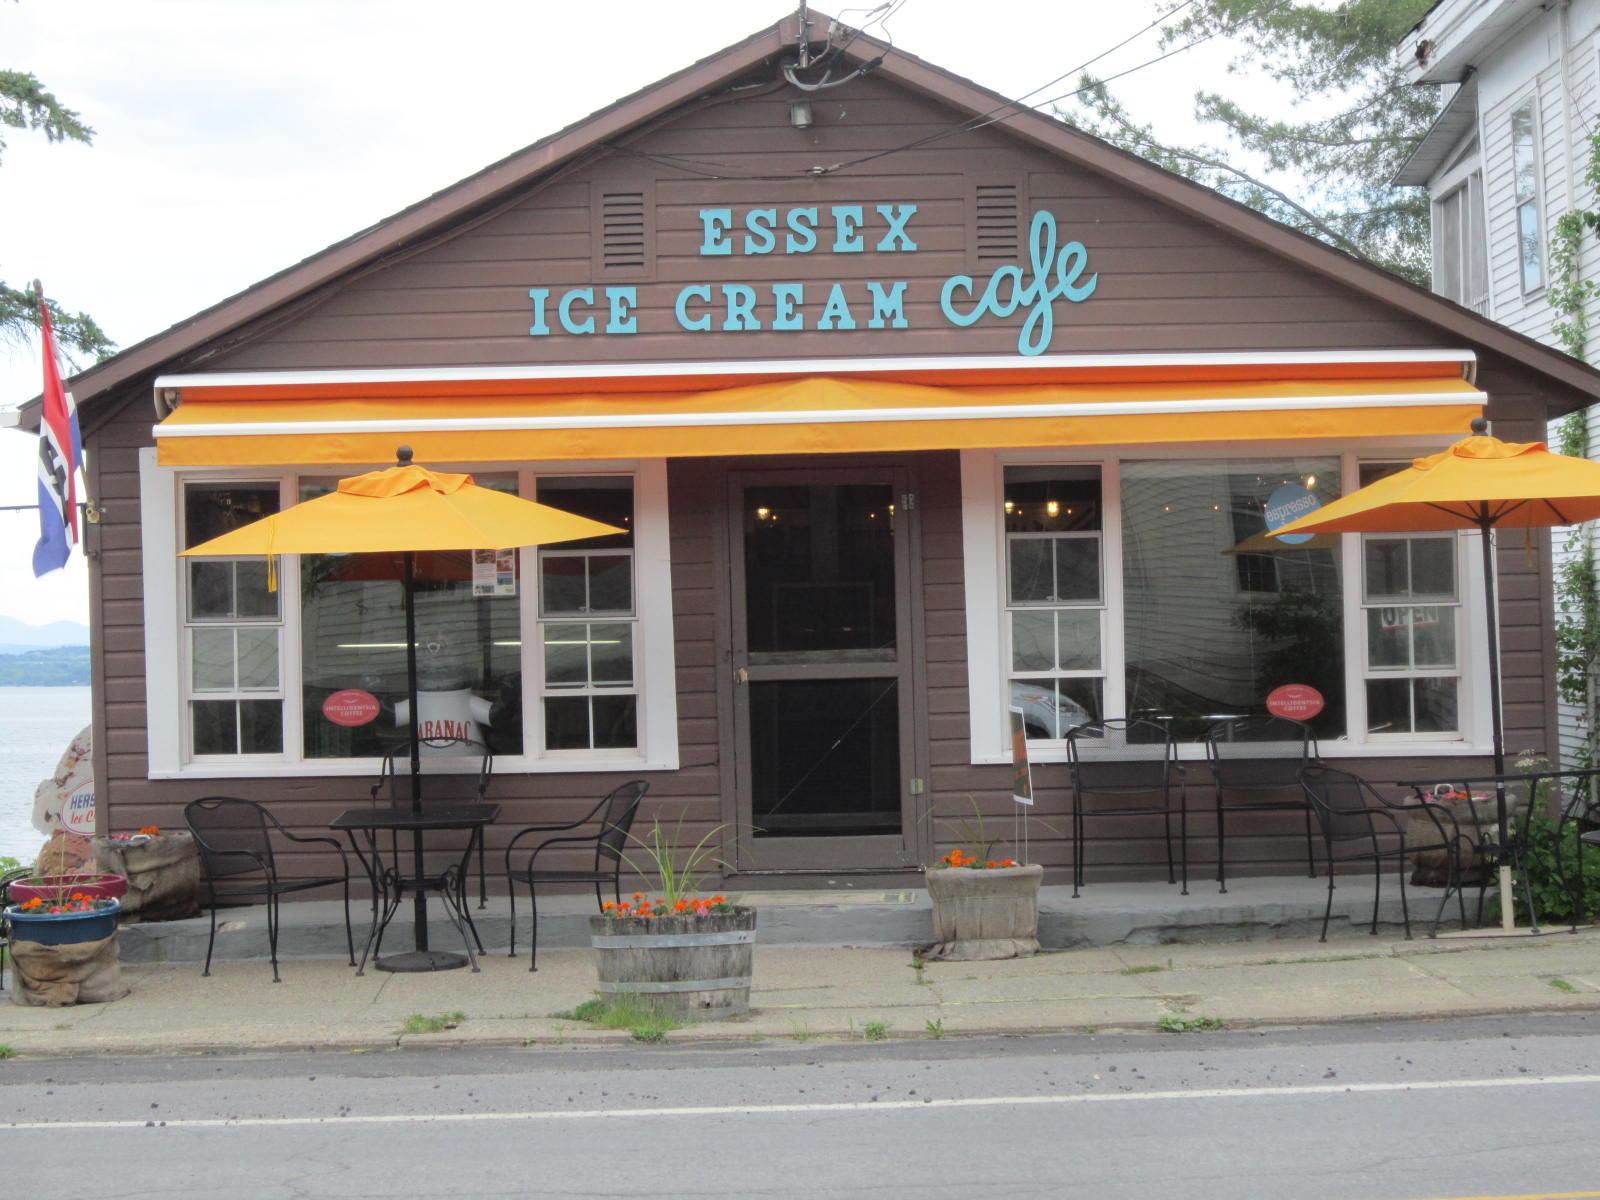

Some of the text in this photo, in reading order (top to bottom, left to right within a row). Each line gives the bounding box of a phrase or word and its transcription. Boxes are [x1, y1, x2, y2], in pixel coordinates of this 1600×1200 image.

[700, 204, 917, 255] ESSEX
[529, 287, 638, 335] ICE
[675, 282, 908, 331] CREAM
[1266, 494, 1316, 522] espresso
[417, 720, 472, 745] ARANAC
[70, 793, 96, 809] HERS
